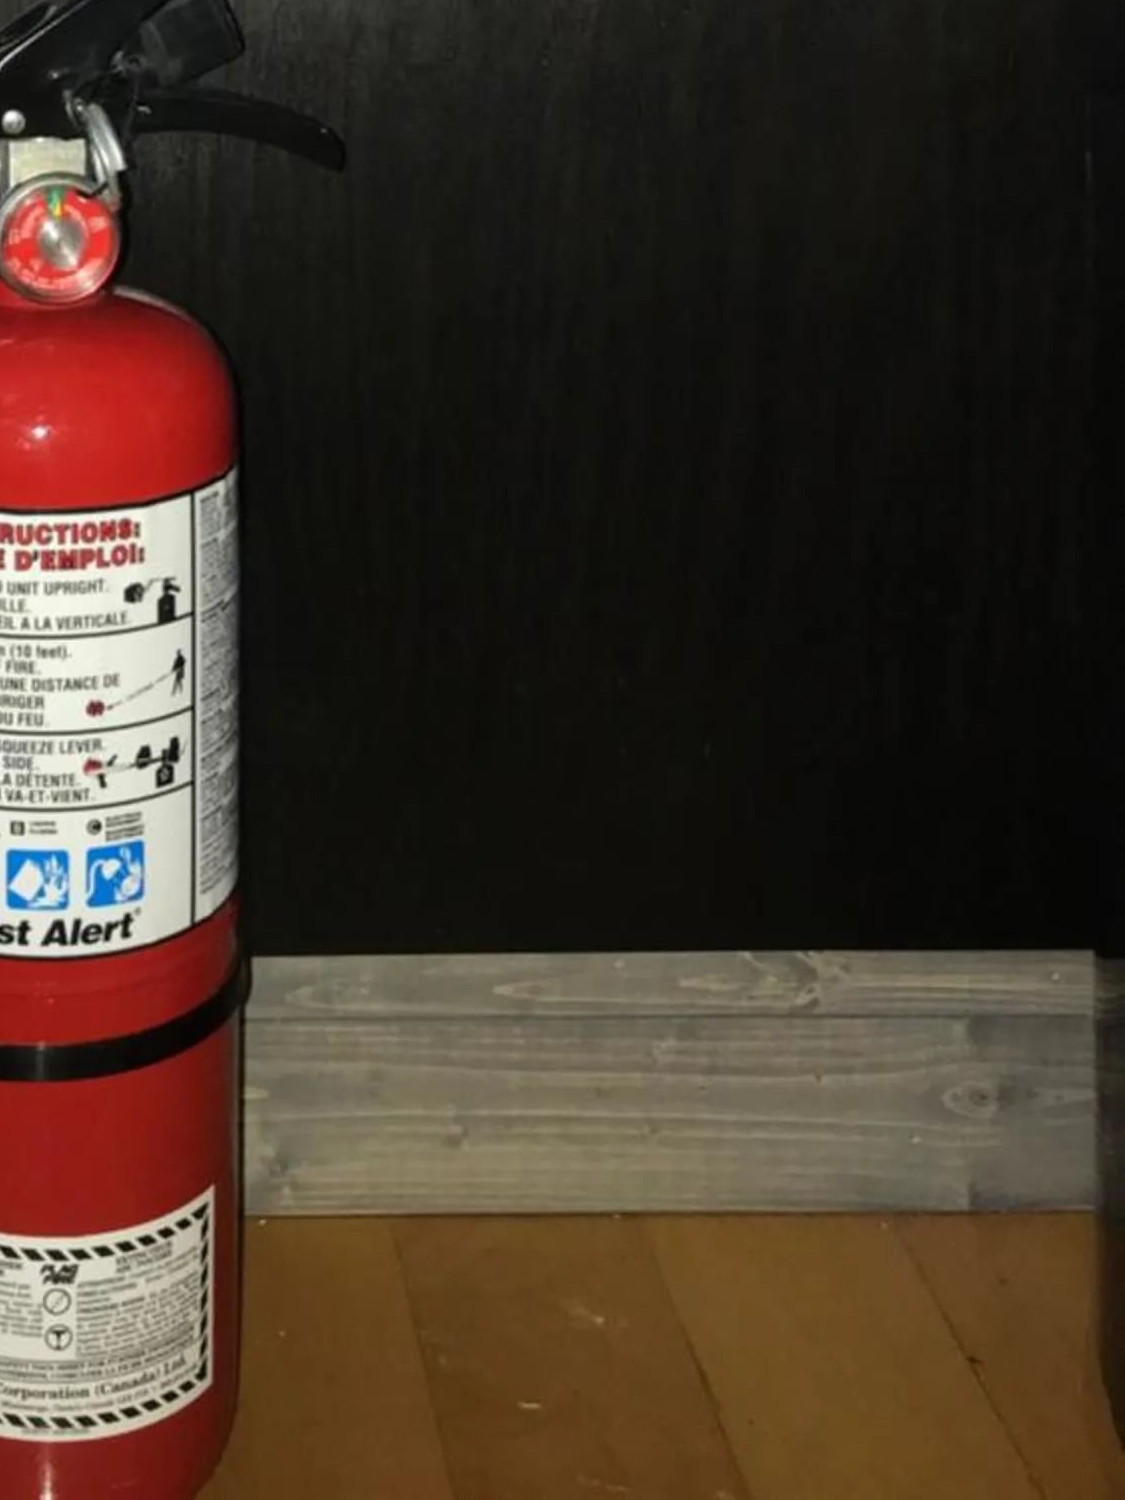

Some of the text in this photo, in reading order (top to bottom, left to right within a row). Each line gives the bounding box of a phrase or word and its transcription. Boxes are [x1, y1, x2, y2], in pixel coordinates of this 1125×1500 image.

[15, 542, 145, 571] D'EMPLOI:
[6, 580, 38, 595] UNIT
[43, 578, 109, 595] UPRIGHT.
[34, 615, 52, 630] LA
[56, 610, 132, 631] VERTICALE.
[9, 643, 32, 658] (10
[5, 659, 41, 674] FIRE.
[31, 674, 98, 692] DISTANCE
[102, 672, 120, 688] DE
[41, 912, 134, 946] Alert
